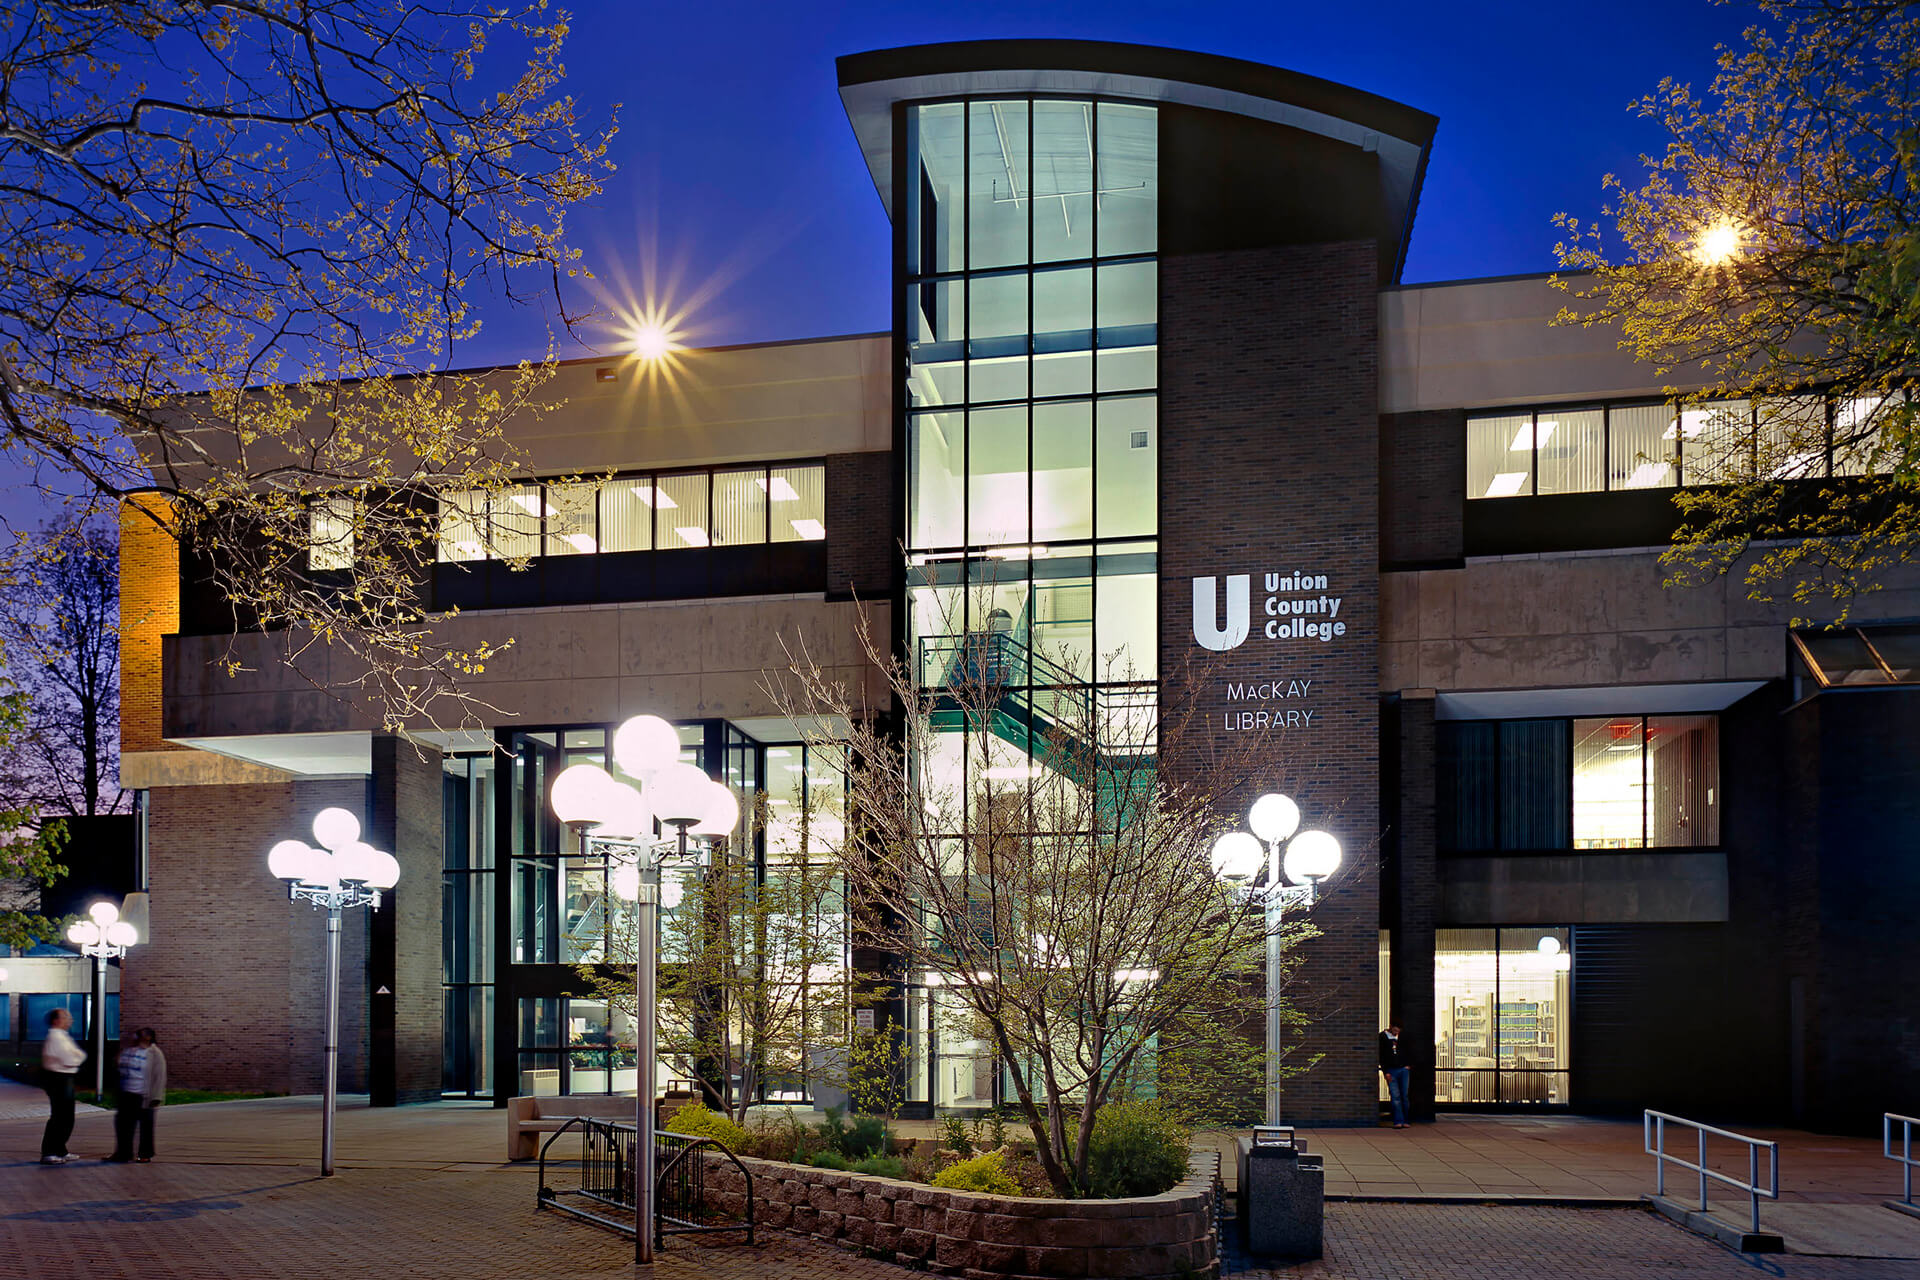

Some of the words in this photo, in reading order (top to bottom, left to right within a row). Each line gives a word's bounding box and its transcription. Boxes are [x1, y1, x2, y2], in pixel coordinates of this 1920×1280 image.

[1265, 570, 1328, 592] Union
[1192, 574, 1250, 651] U
[1265, 595, 1341, 618] County
[1265, 618, 1346, 642] College
[1225, 710, 1313, 731] LIBRARY
